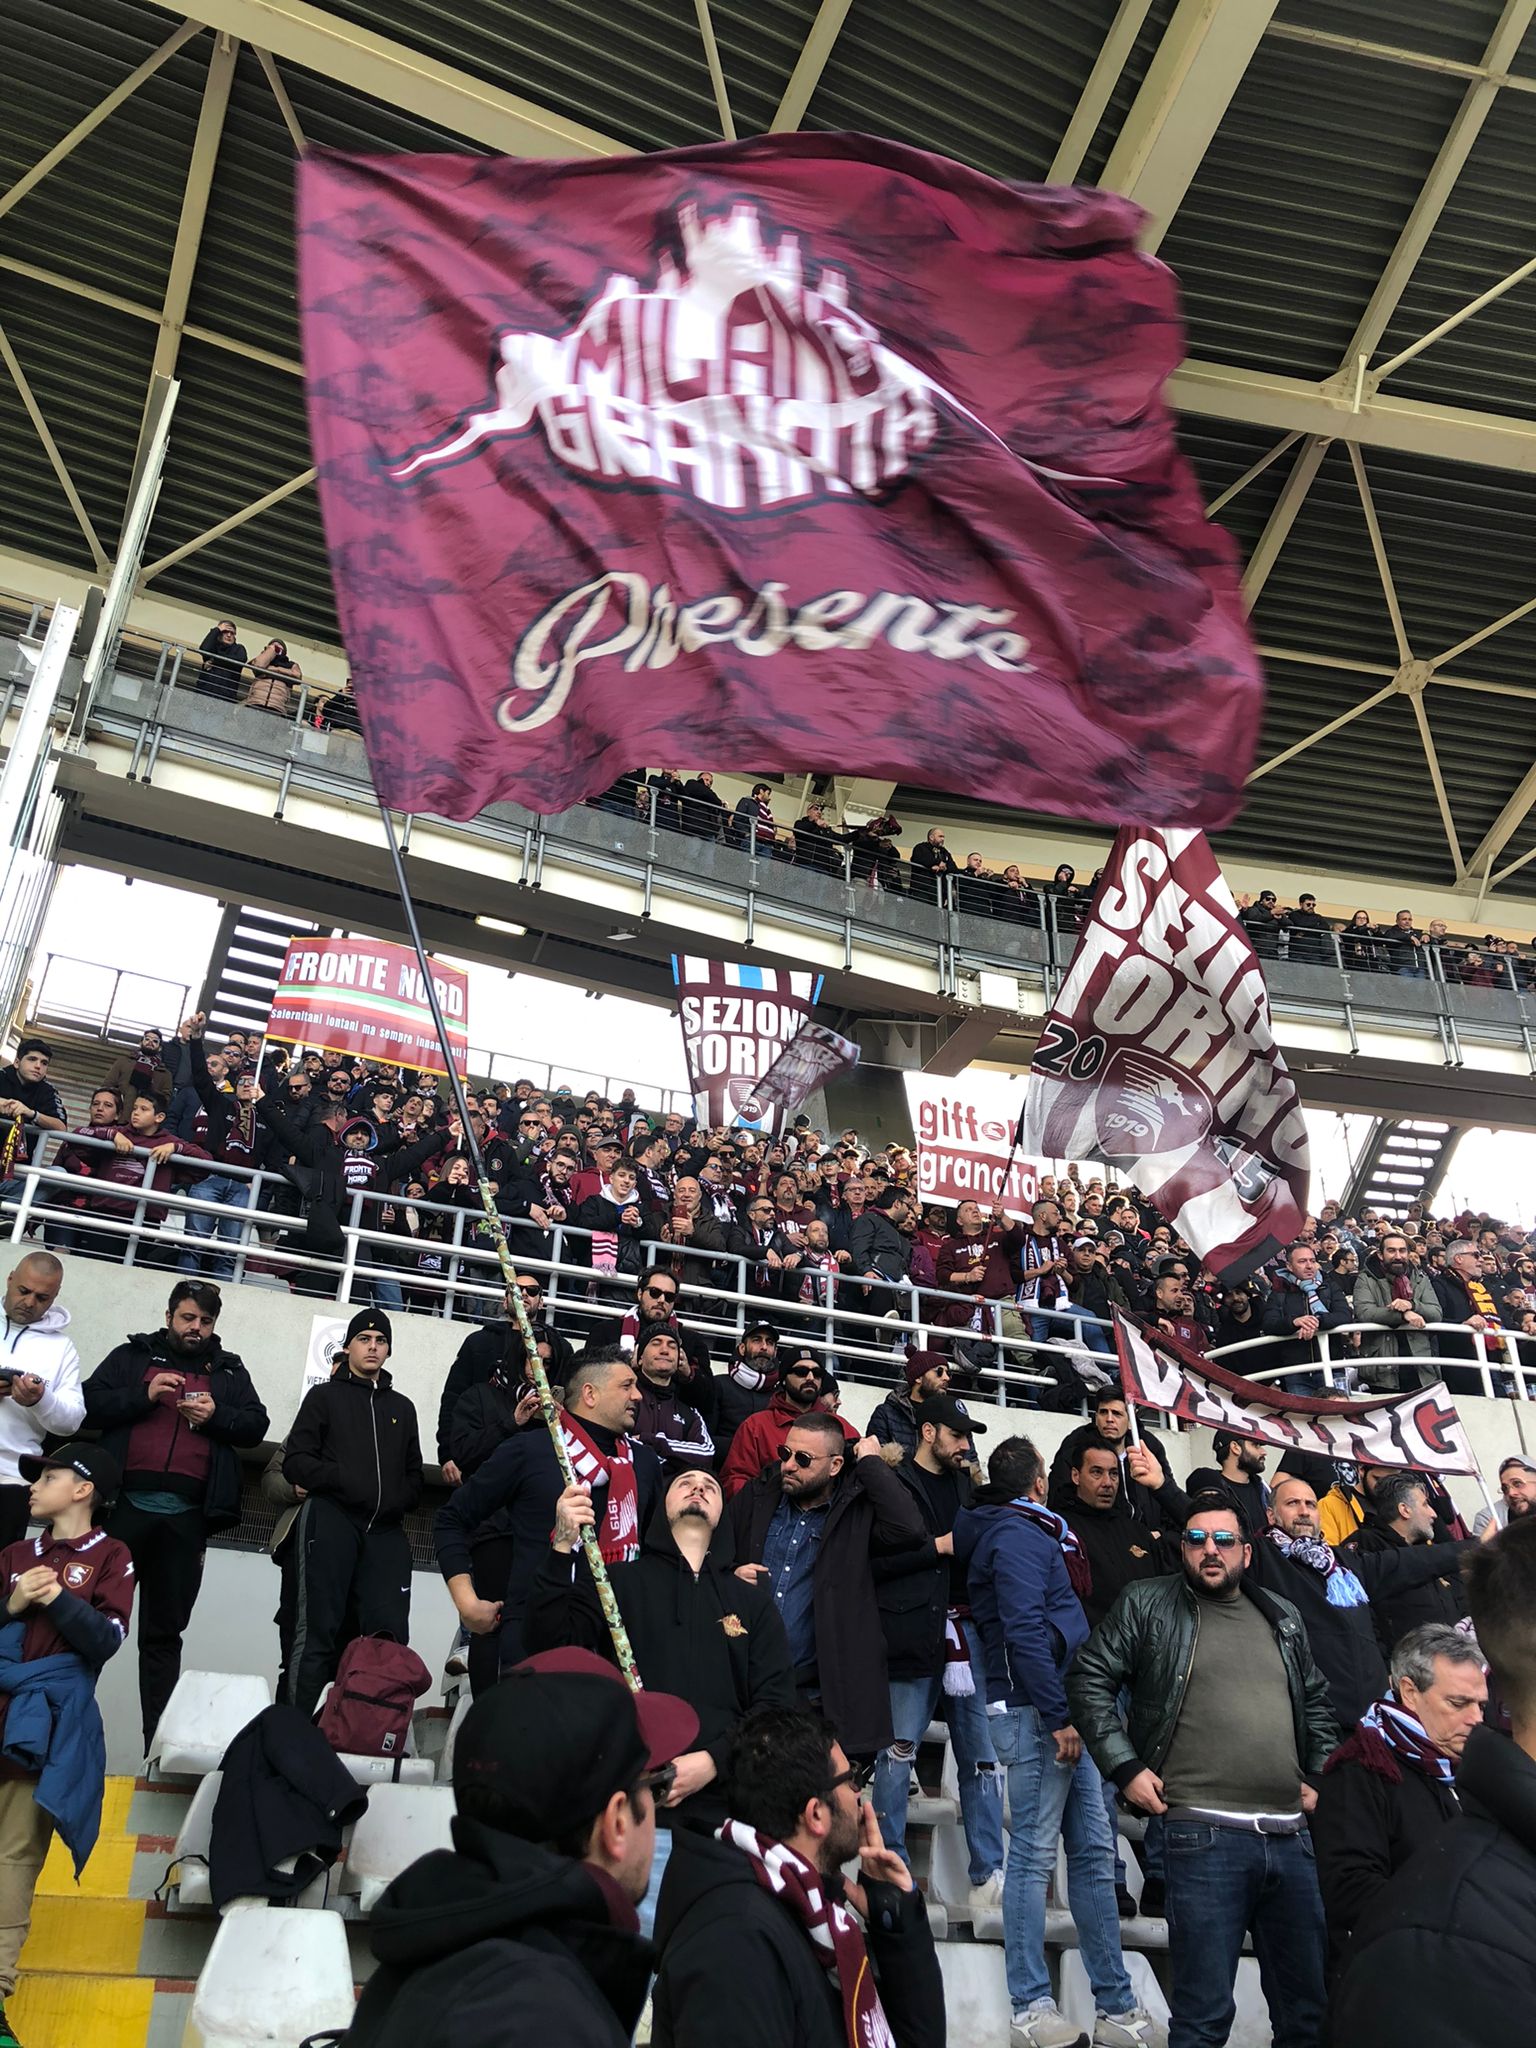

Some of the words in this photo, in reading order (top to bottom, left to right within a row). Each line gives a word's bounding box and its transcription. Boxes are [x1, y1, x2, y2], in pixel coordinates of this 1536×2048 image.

[498, 571, 1038, 732] Presente
[284, 951, 390, 992] FRONTE
[361, 1023, 375, 1036] ma
[379, 1027, 413, 1047] sempre
[416, 1035, 462, 1058] innamati
[1031, 1019, 1107, 1081] 20
[1104, 1112, 1149, 1138] 1919
[919, 1151, 1036, 1204] granata
[1113, 1314, 1479, 1476] VIKING
[607, 1497, 620, 1531] 1919
